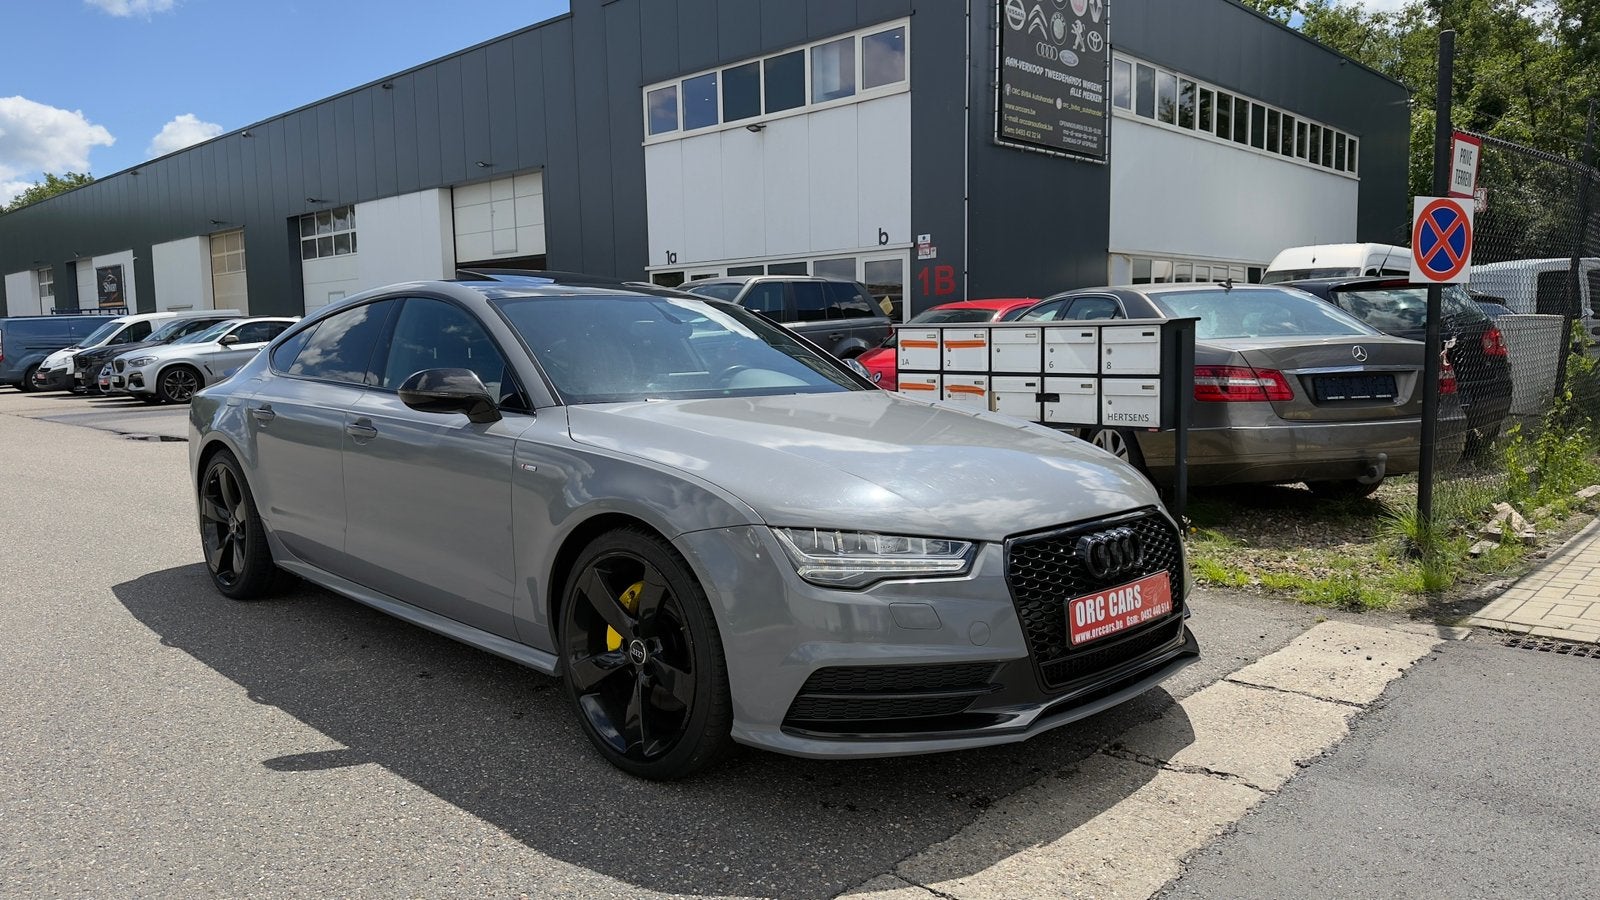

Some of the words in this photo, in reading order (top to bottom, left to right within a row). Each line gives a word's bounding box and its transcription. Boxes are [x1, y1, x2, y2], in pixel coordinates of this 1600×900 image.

[1005, 56, 1043, 74] AAN-VERKOOP
[1044, 68, 1082, 86] TWEEDEHANDS
[1082, 80, 1102, 92] WAGENS
[1070, 87, 1082, 98] ALLE
[1082, 91, 1102, 103] MERKEN
[1460, 148, 1472, 166] PRIVE
[1455, 168, 1472, 187] TERREIN
[878, 227, 889, 245] b
[665, 250, 677, 265] 1a
[918, 264, 956, 296] 1B
[901, 358, 910, 366] 1A
[1049, 360, 1054, 368] 6
[1106, 361, 1112, 369] 8
[1107, 412, 1150, 422] HERTSENS
[1075, 596, 1105, 627] ORC
[1108, 585, 1142, 617] CARS
[1075, 620, 1124, 643] www.orccars.be
[1127, 615, 1139, 626] Gsm:
